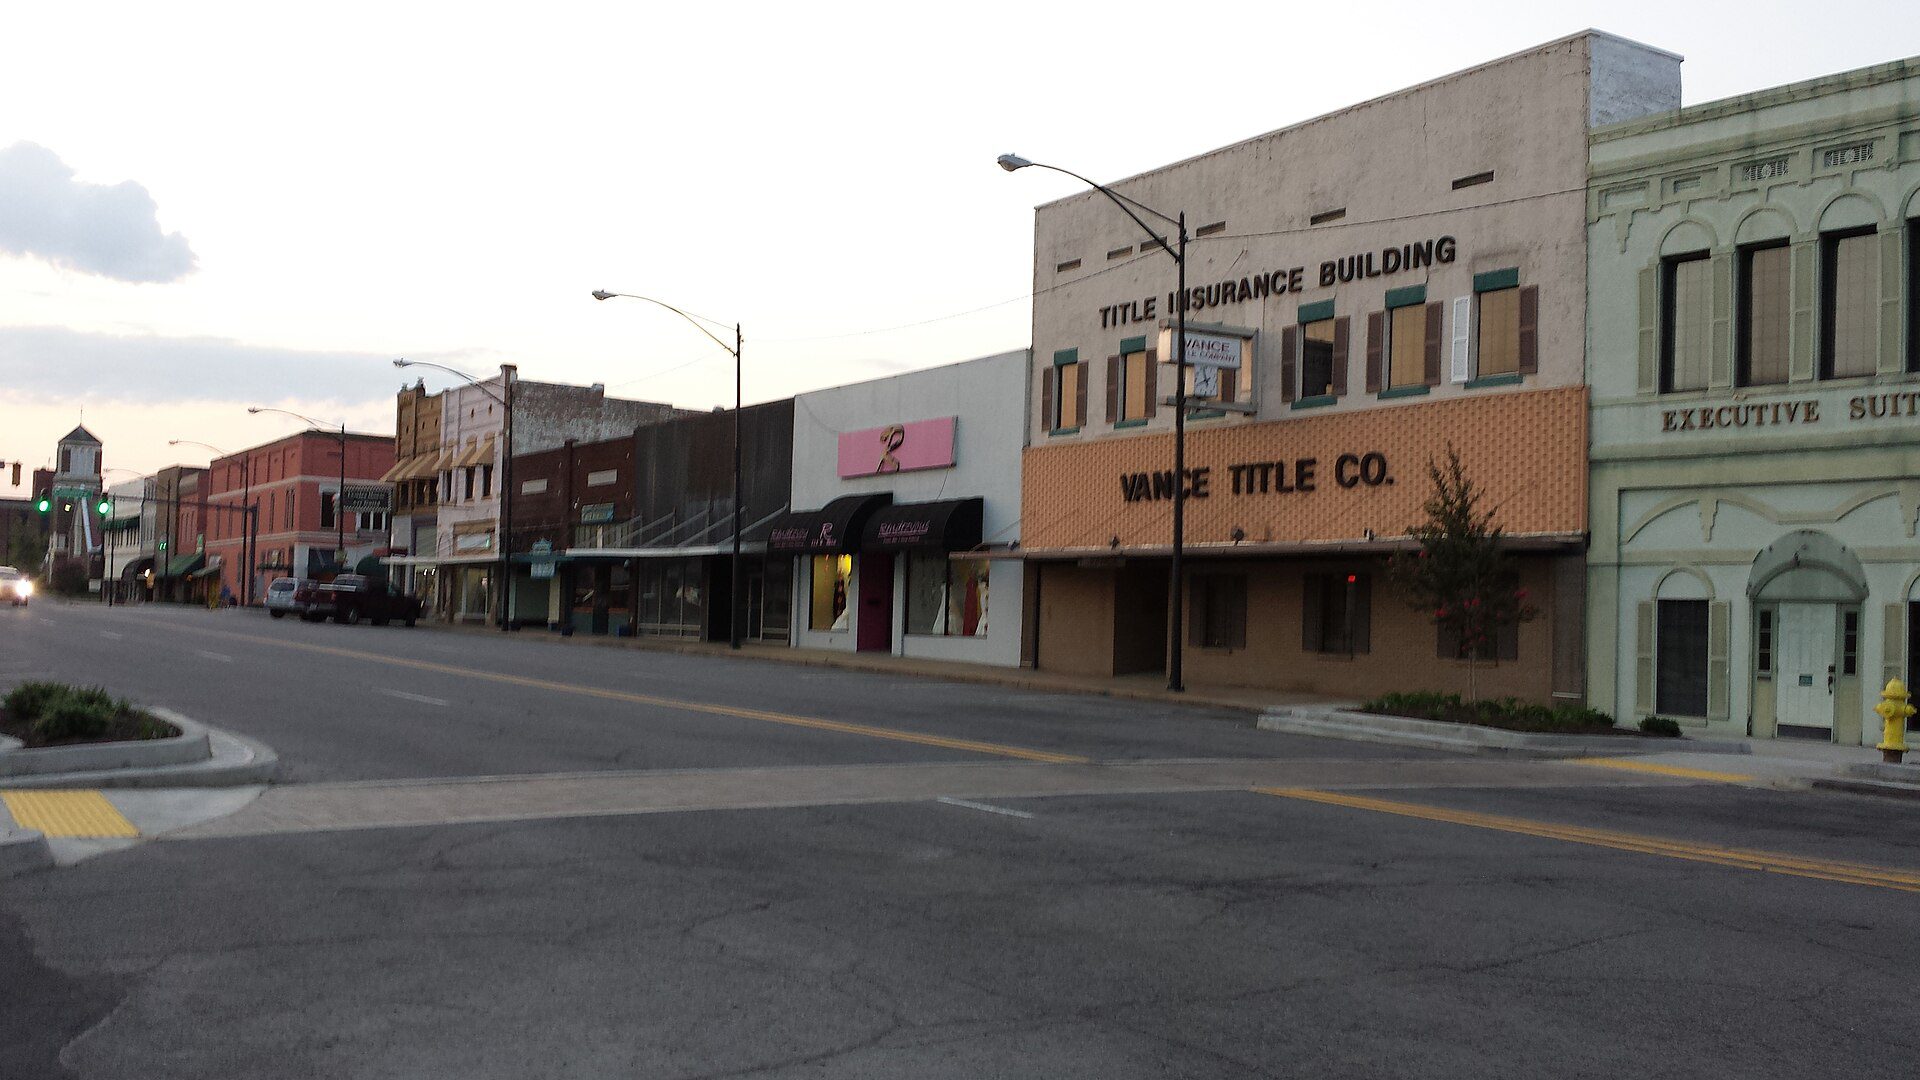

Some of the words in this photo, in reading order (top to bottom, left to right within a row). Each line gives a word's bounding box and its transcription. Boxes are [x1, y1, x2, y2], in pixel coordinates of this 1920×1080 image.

[1099, 296, 1156, 329] TITLE
[1167, 266, 1304, 315] INSURANCE
[1319, 235, 1456, 288] BUILDING
[1184, 338, 1230, 352] VANCE
[1661, 400, 1820, 433] EXECUTIVE
[876, 423, 905, 473] R
[1120, 466, 1210, 502] VANCE
[1228, 457, 1317, 495] TITLE
[1334, 452, 1394, 489] CO.
